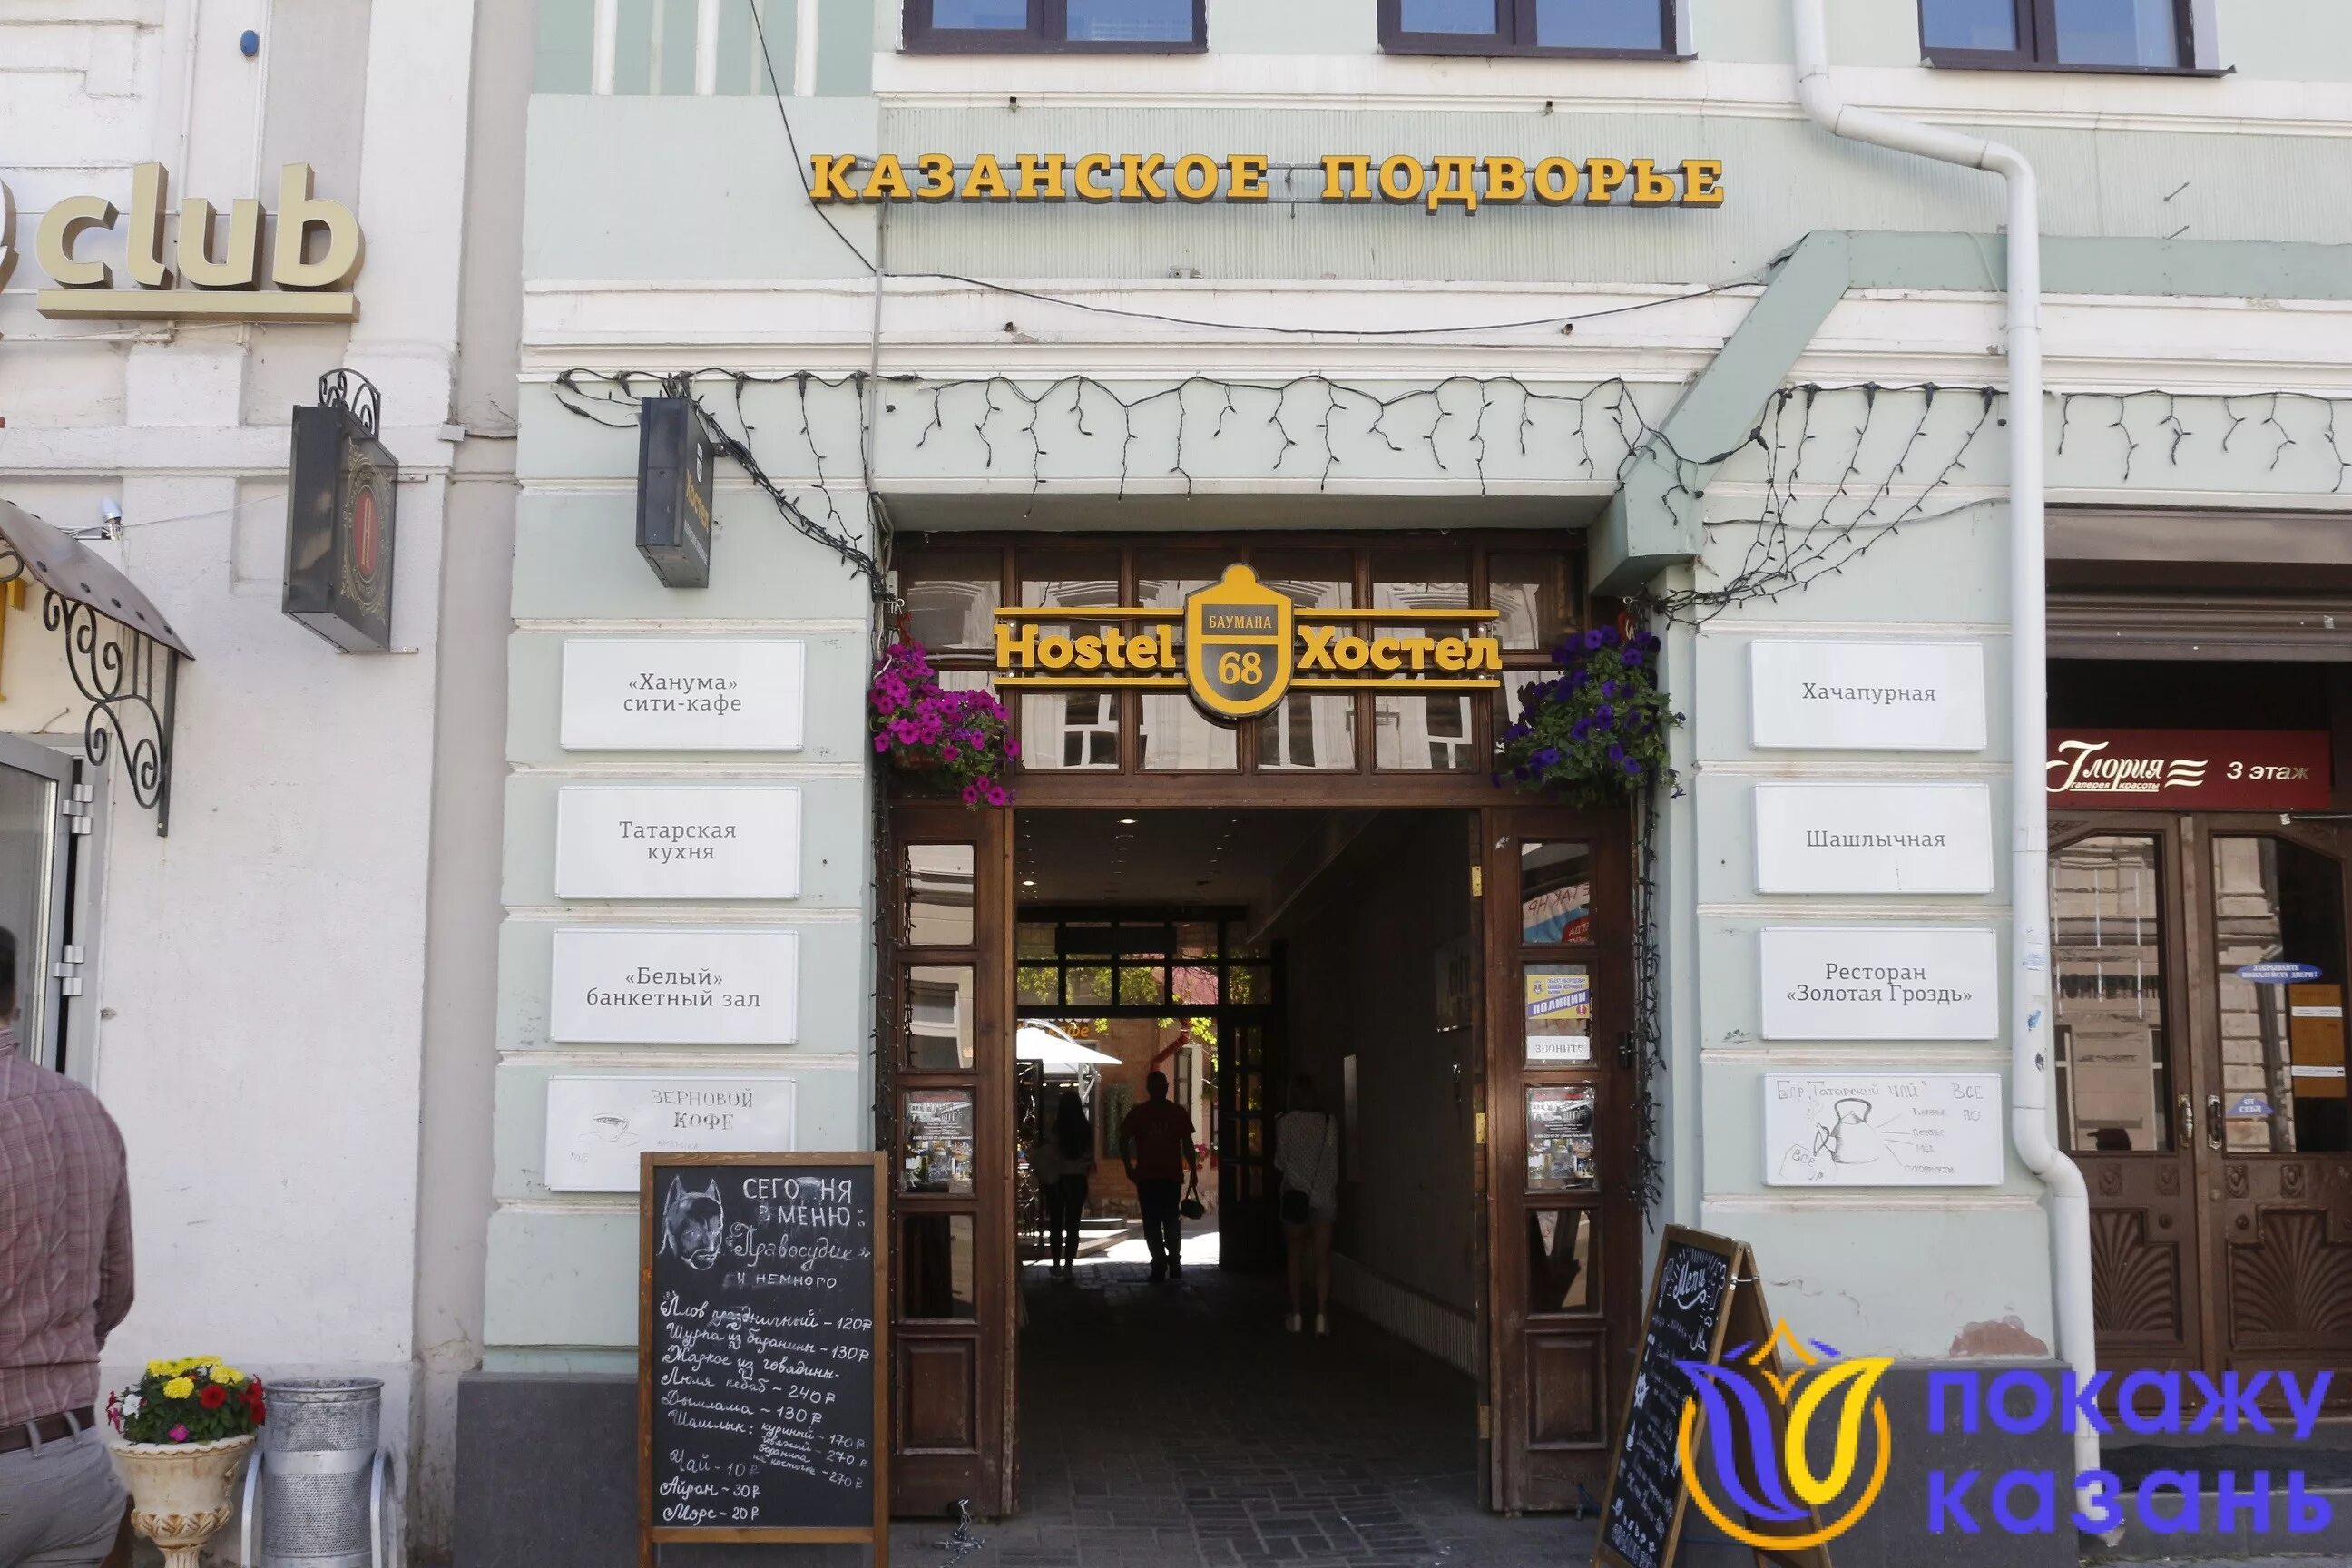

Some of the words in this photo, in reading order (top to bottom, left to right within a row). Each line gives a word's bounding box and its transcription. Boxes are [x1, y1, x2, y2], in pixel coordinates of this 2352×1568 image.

[808, 153, 1270, 204] КАЗАНСКОЕ
[1320, 154, 1725, 216] ПОДВОРЬЕ
[36, 161, 365, 291] club
[1208, 614, 1272, 630] БАУМАНА
[994, 623, 1177, 670] Hostel
[1297, 624, 1503, 671] Хостел
[1218, 652, 1263, 686] 68
[628, 673, 738, 695] «Ханума»
[1802, 682, 1936, 704] Хачапурная
[623, 693, 742, 715] сити-кафе
[2226, 761, 2243, 779] 3
[2249, 765, 2309, 780] этаж
[2070, 781, 2111, 790] галерея
[2118, 781, 2161, 790] красоты
[619, 820, 737, 843] Татарская
[1806, 830, 1946, 848] Шашлычная
[646, 845, 715, 864] кухня
[625, 966, 723, 985] «Белый»
[1826, 963, 1926, 985] Ресторан
[586, 987, 714, 1006] банкетный
[722, 993, 760, 1007] зал
[1533, 991, 1586, 1014] ПОЛИЦИИ
[1787, 984, 1883, 1002] «Золотая
[1889, 984, 1973, 1005] Гроздь»
[674, 1112, 734, 1130] КОФЕ
[743, 1177, 852, 1204] СЕГОНЯ
[663, 1503, 717, 1525] Морс
